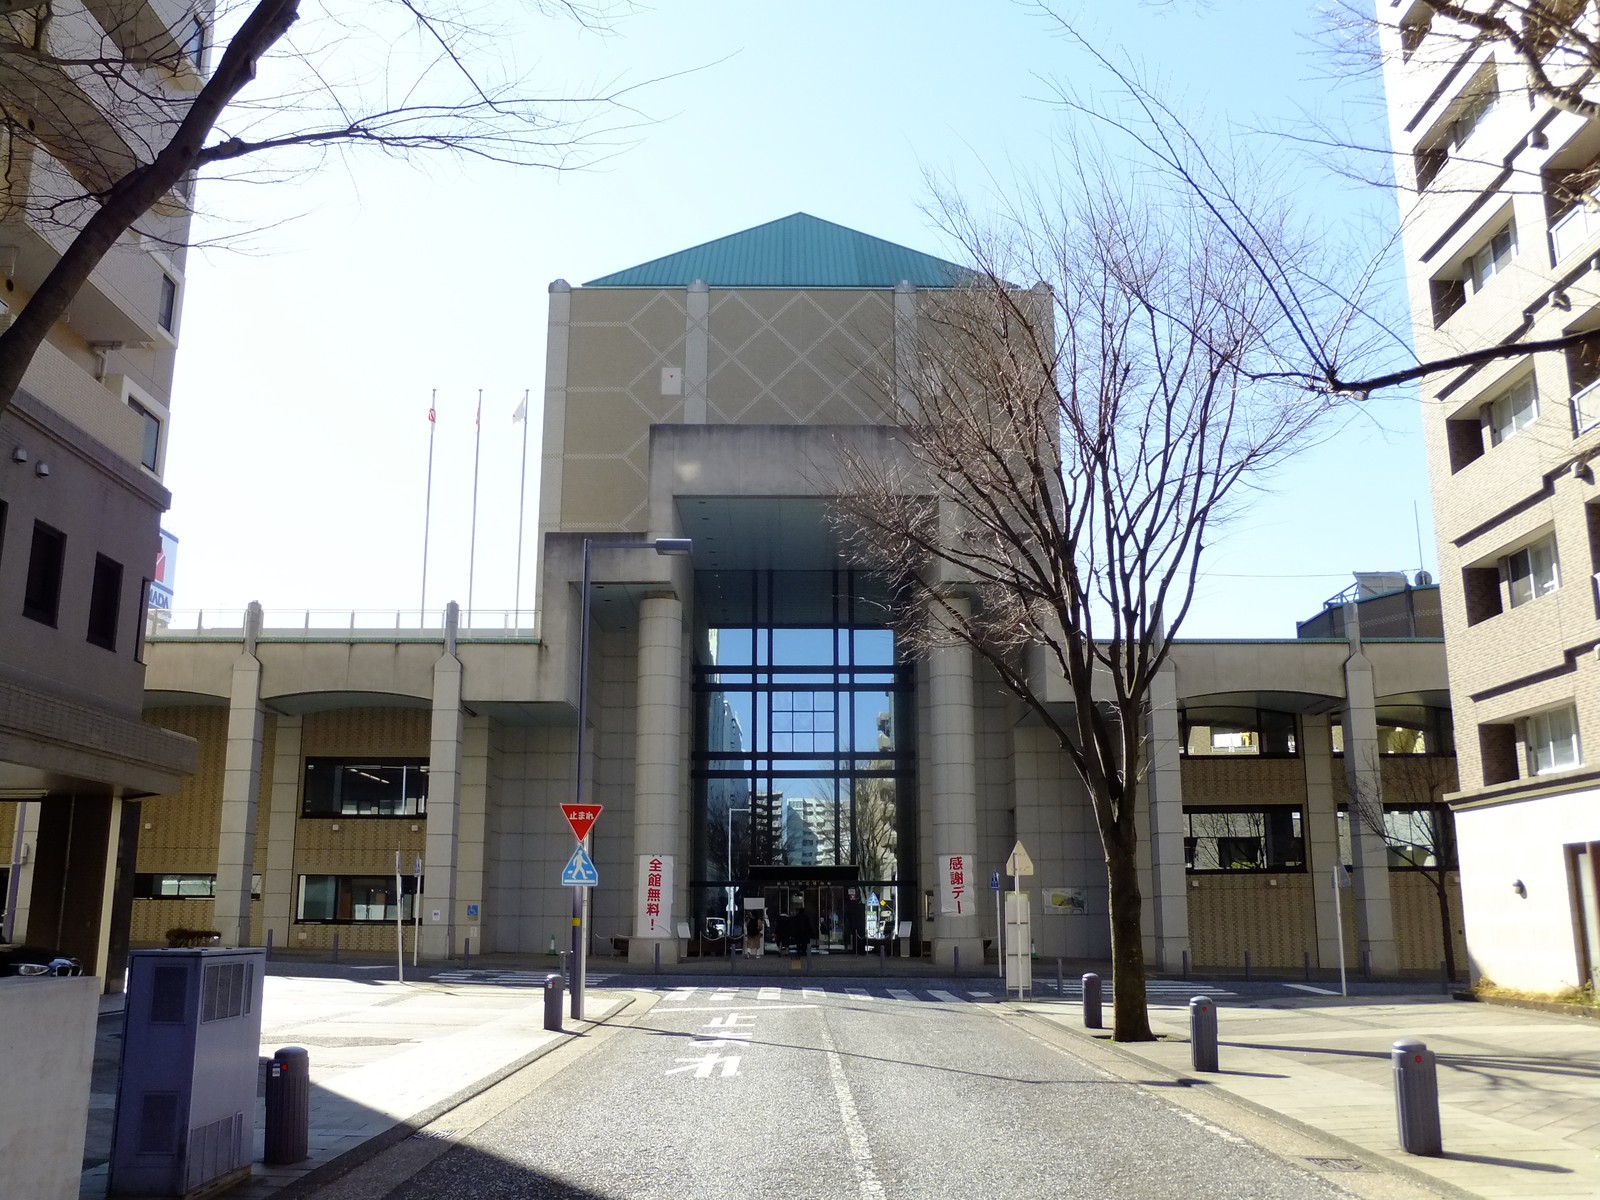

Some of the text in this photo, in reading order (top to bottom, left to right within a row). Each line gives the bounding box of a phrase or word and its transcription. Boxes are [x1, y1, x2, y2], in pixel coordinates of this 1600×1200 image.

[569, 811, 594, 820] 止まれ
[646, 858, 663, 931] 全館無料！
[949, 856, 965, 914] 感謝デー
[664, 1013, 758, 1077] 止まれ
